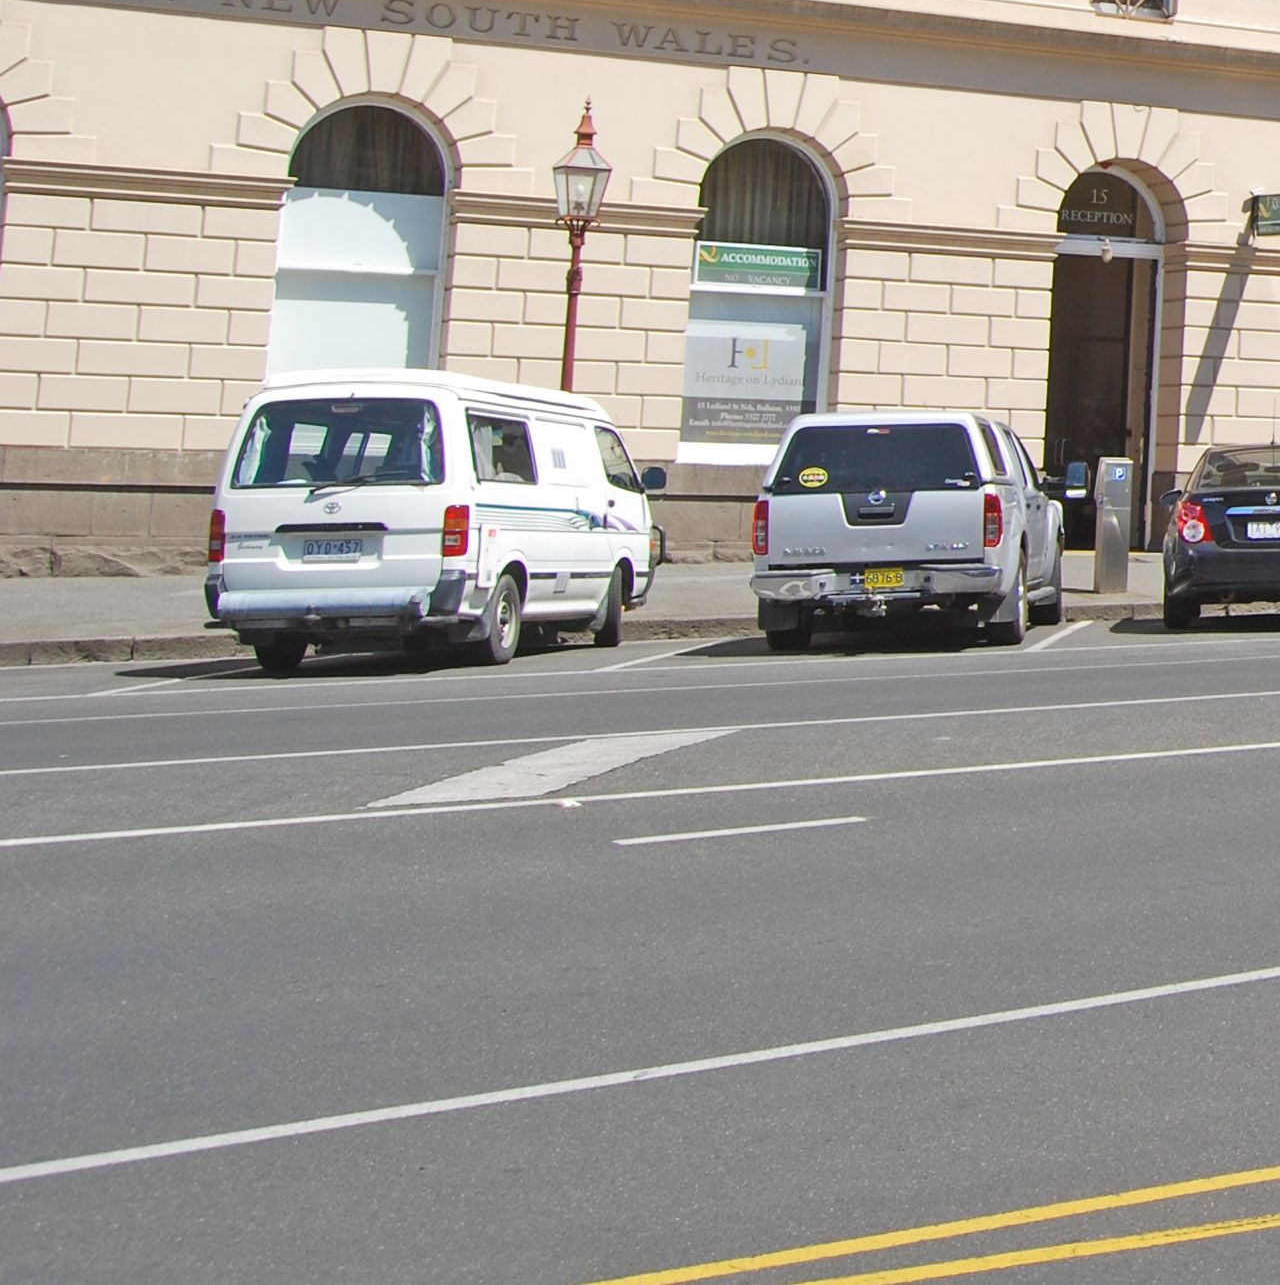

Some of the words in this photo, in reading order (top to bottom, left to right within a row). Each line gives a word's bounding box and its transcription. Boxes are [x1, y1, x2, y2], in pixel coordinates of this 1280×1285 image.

[1091, 189, 1109, 205] 15
[1061, 209, 1133, 225] RECEPTION
[720, 252, 818, 268] ACCOMMODATION
[724, 273, 739, 282] NO
[748, 274, 792, 286] VACANCY
[695, 371, 744, 389] Heritage
[744, 376, 761, 385] on
